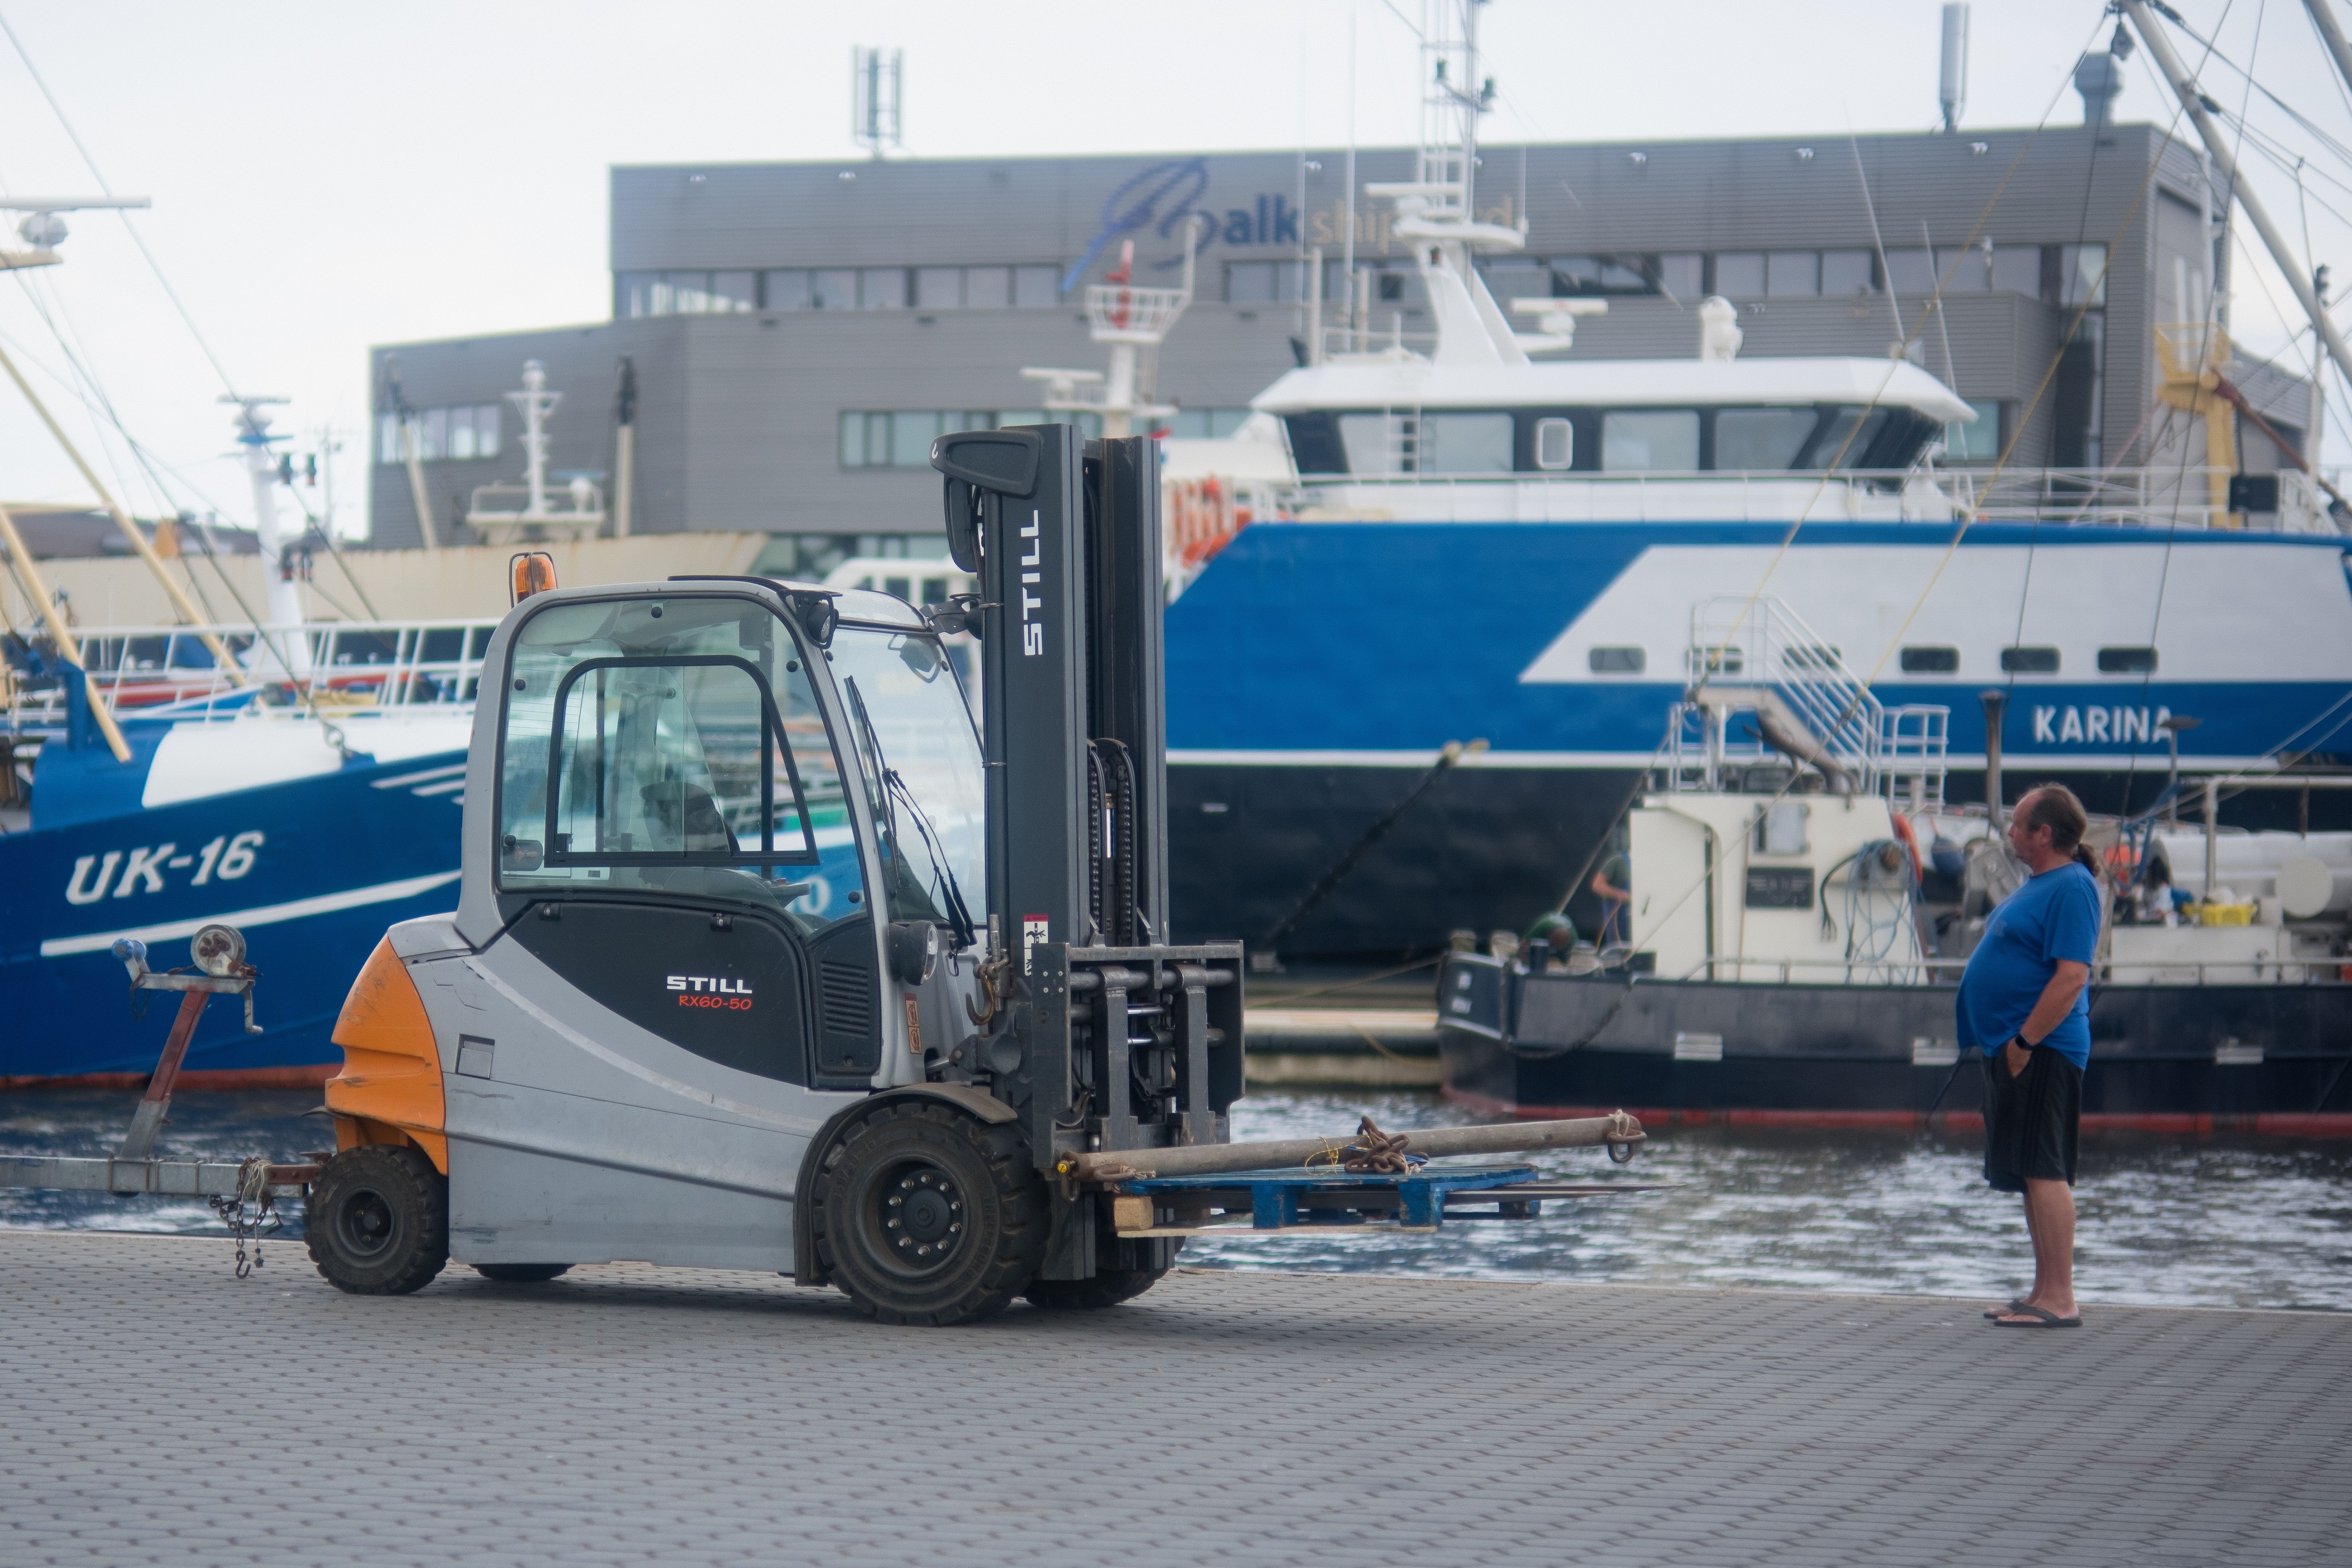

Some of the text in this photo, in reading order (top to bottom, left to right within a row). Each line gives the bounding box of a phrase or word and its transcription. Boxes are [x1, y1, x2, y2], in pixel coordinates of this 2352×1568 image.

[1021, 510, 1043, 656] STILL
[2035, 704, 2173, 744] KARINA
[65, 830, 266, 905] UK-16
[667, 976, 752, 994] STILL
[679, 995, 752, 1010] RX60-50
